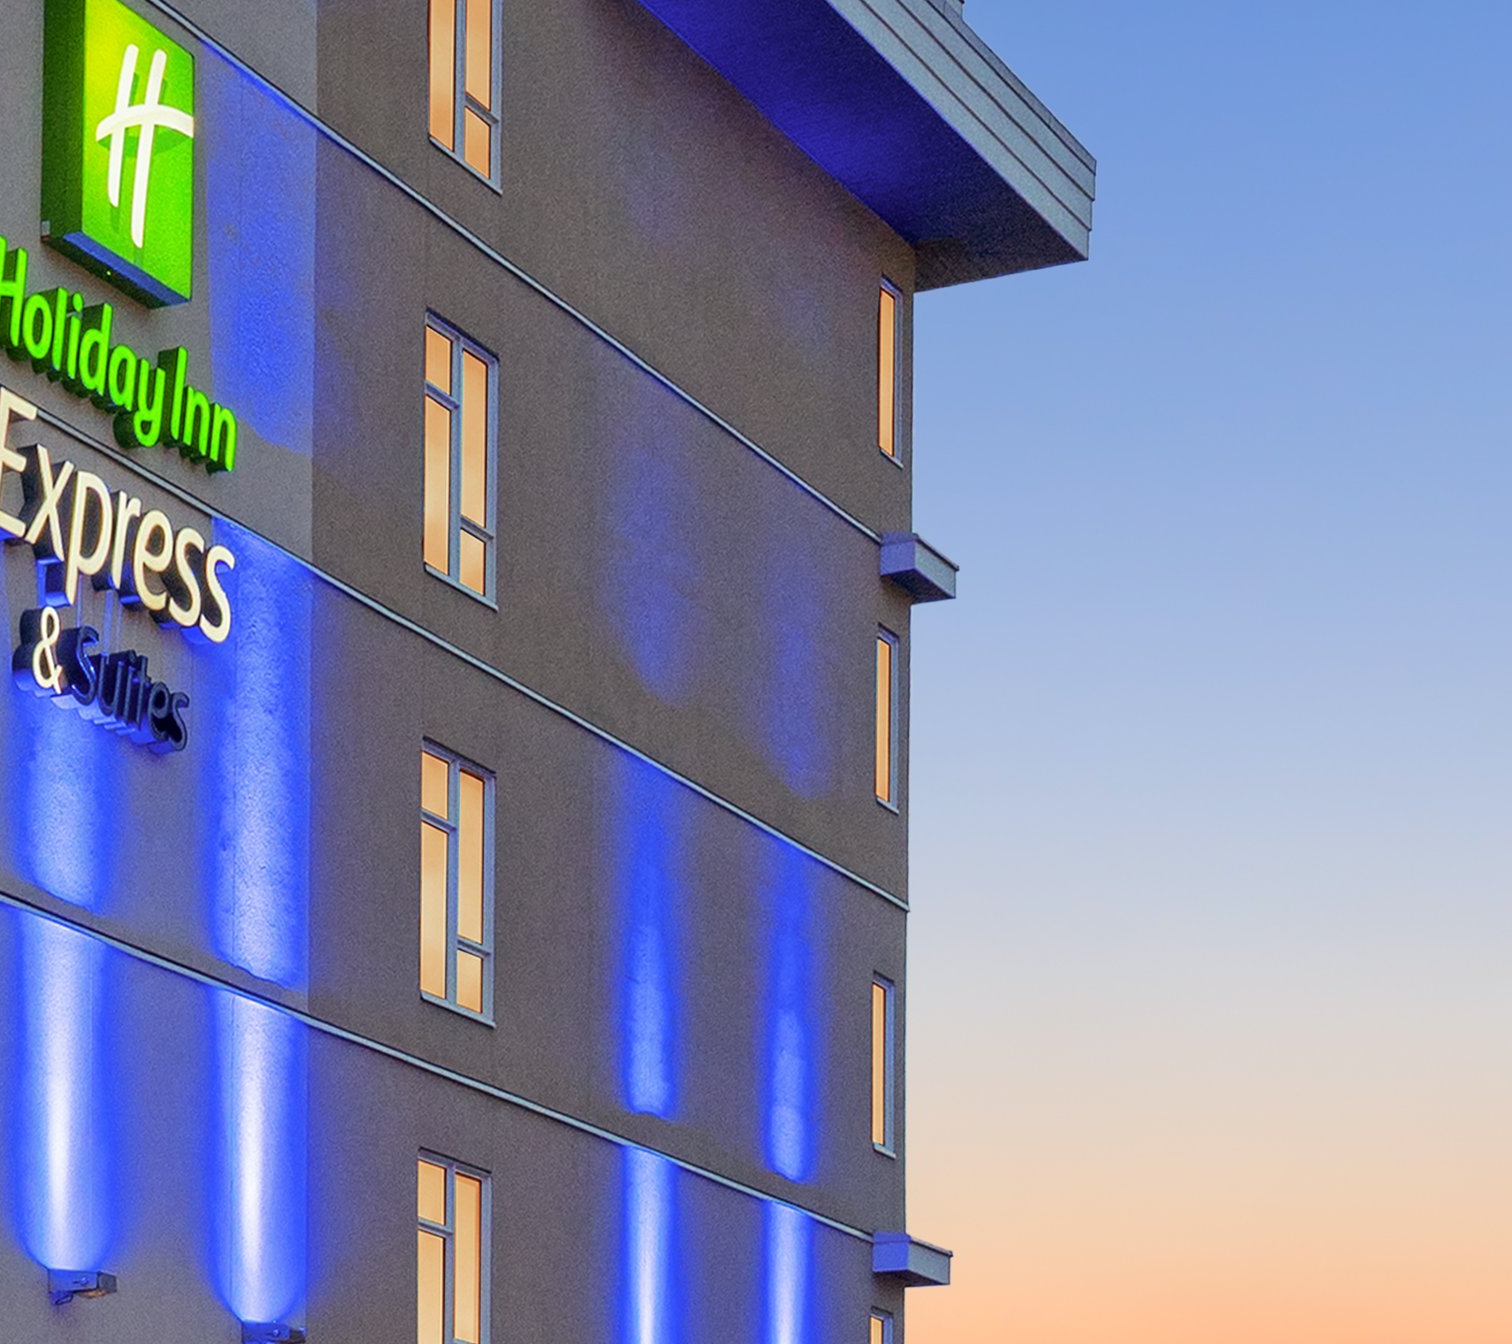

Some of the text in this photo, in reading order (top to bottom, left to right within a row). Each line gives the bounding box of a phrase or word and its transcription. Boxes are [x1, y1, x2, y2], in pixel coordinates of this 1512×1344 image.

[170, 346, 238, 472] Inn
[32, 606, 191, 752] & Suites
